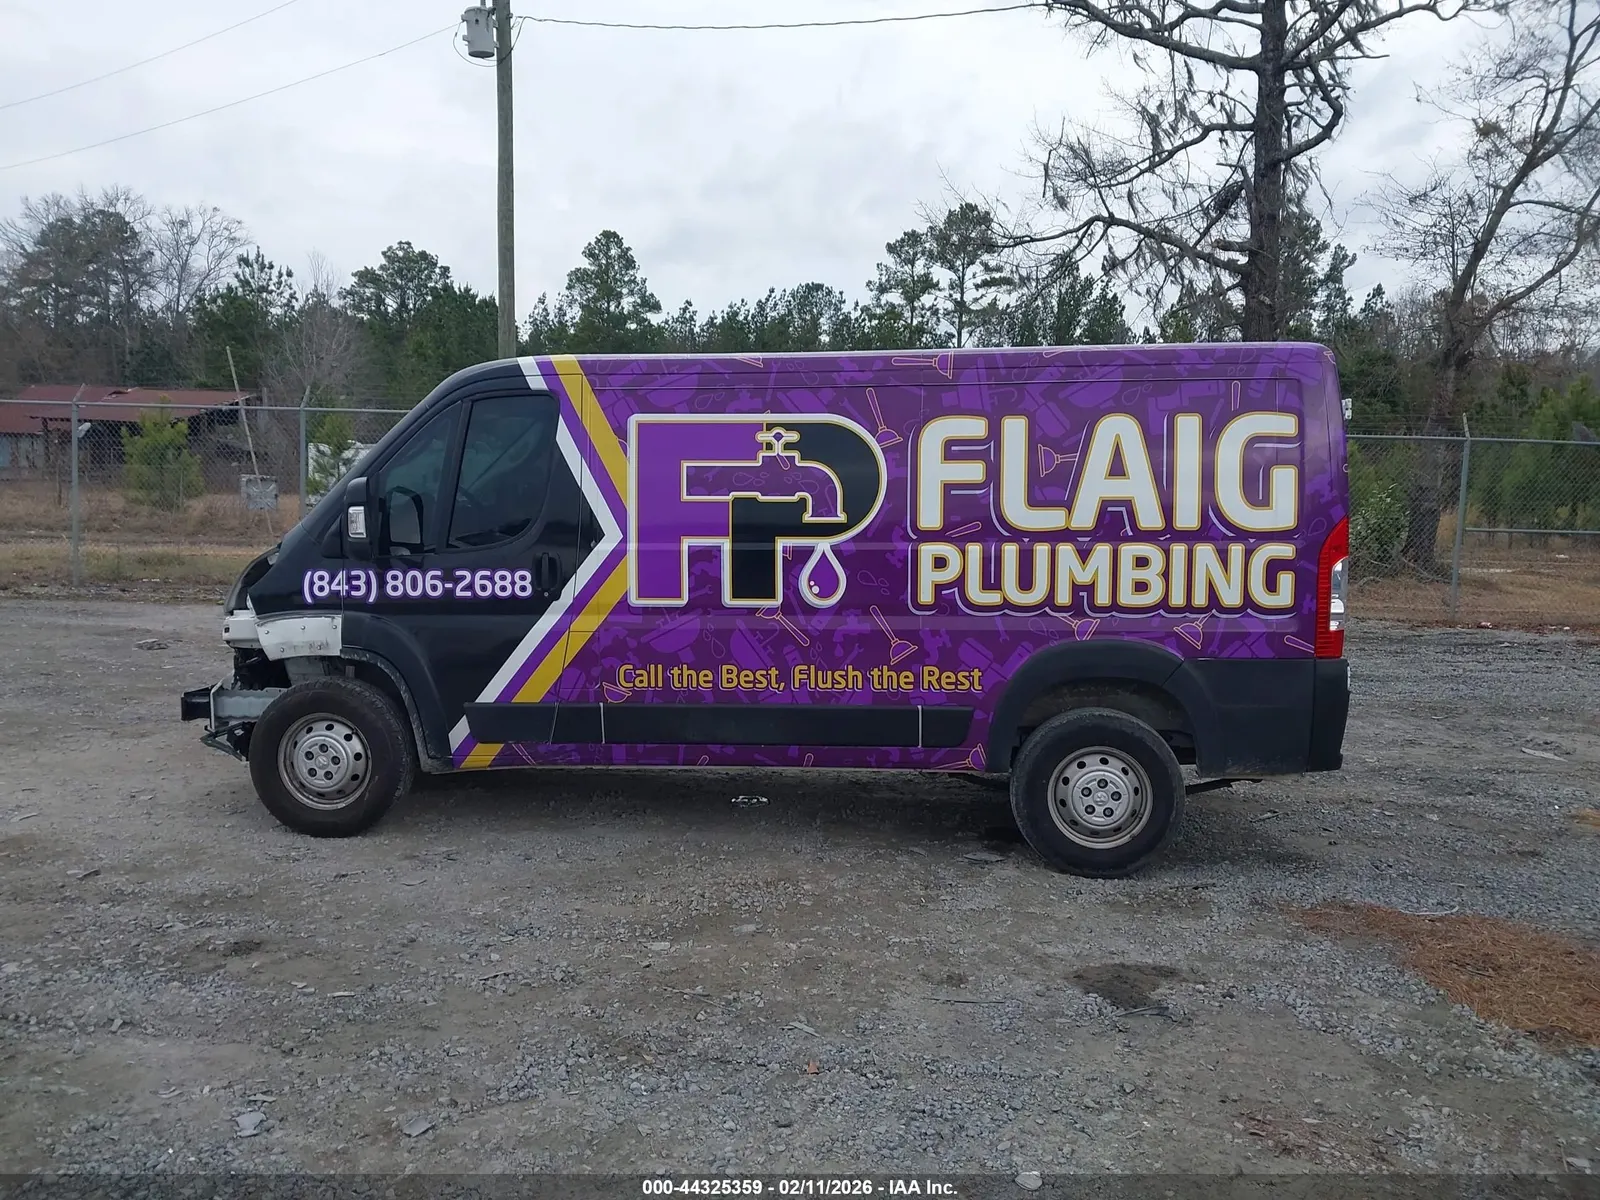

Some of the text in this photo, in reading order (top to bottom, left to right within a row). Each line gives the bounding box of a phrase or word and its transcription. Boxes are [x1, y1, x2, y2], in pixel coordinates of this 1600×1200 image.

[916, 411, 1300, 532] FLAIG
[303, 569, 533, 604] (843) 806-2688
[917, 541, 1297, 608] PLUMBING
[617, 664, 983, 692] Call the Best, Flush the Rest
